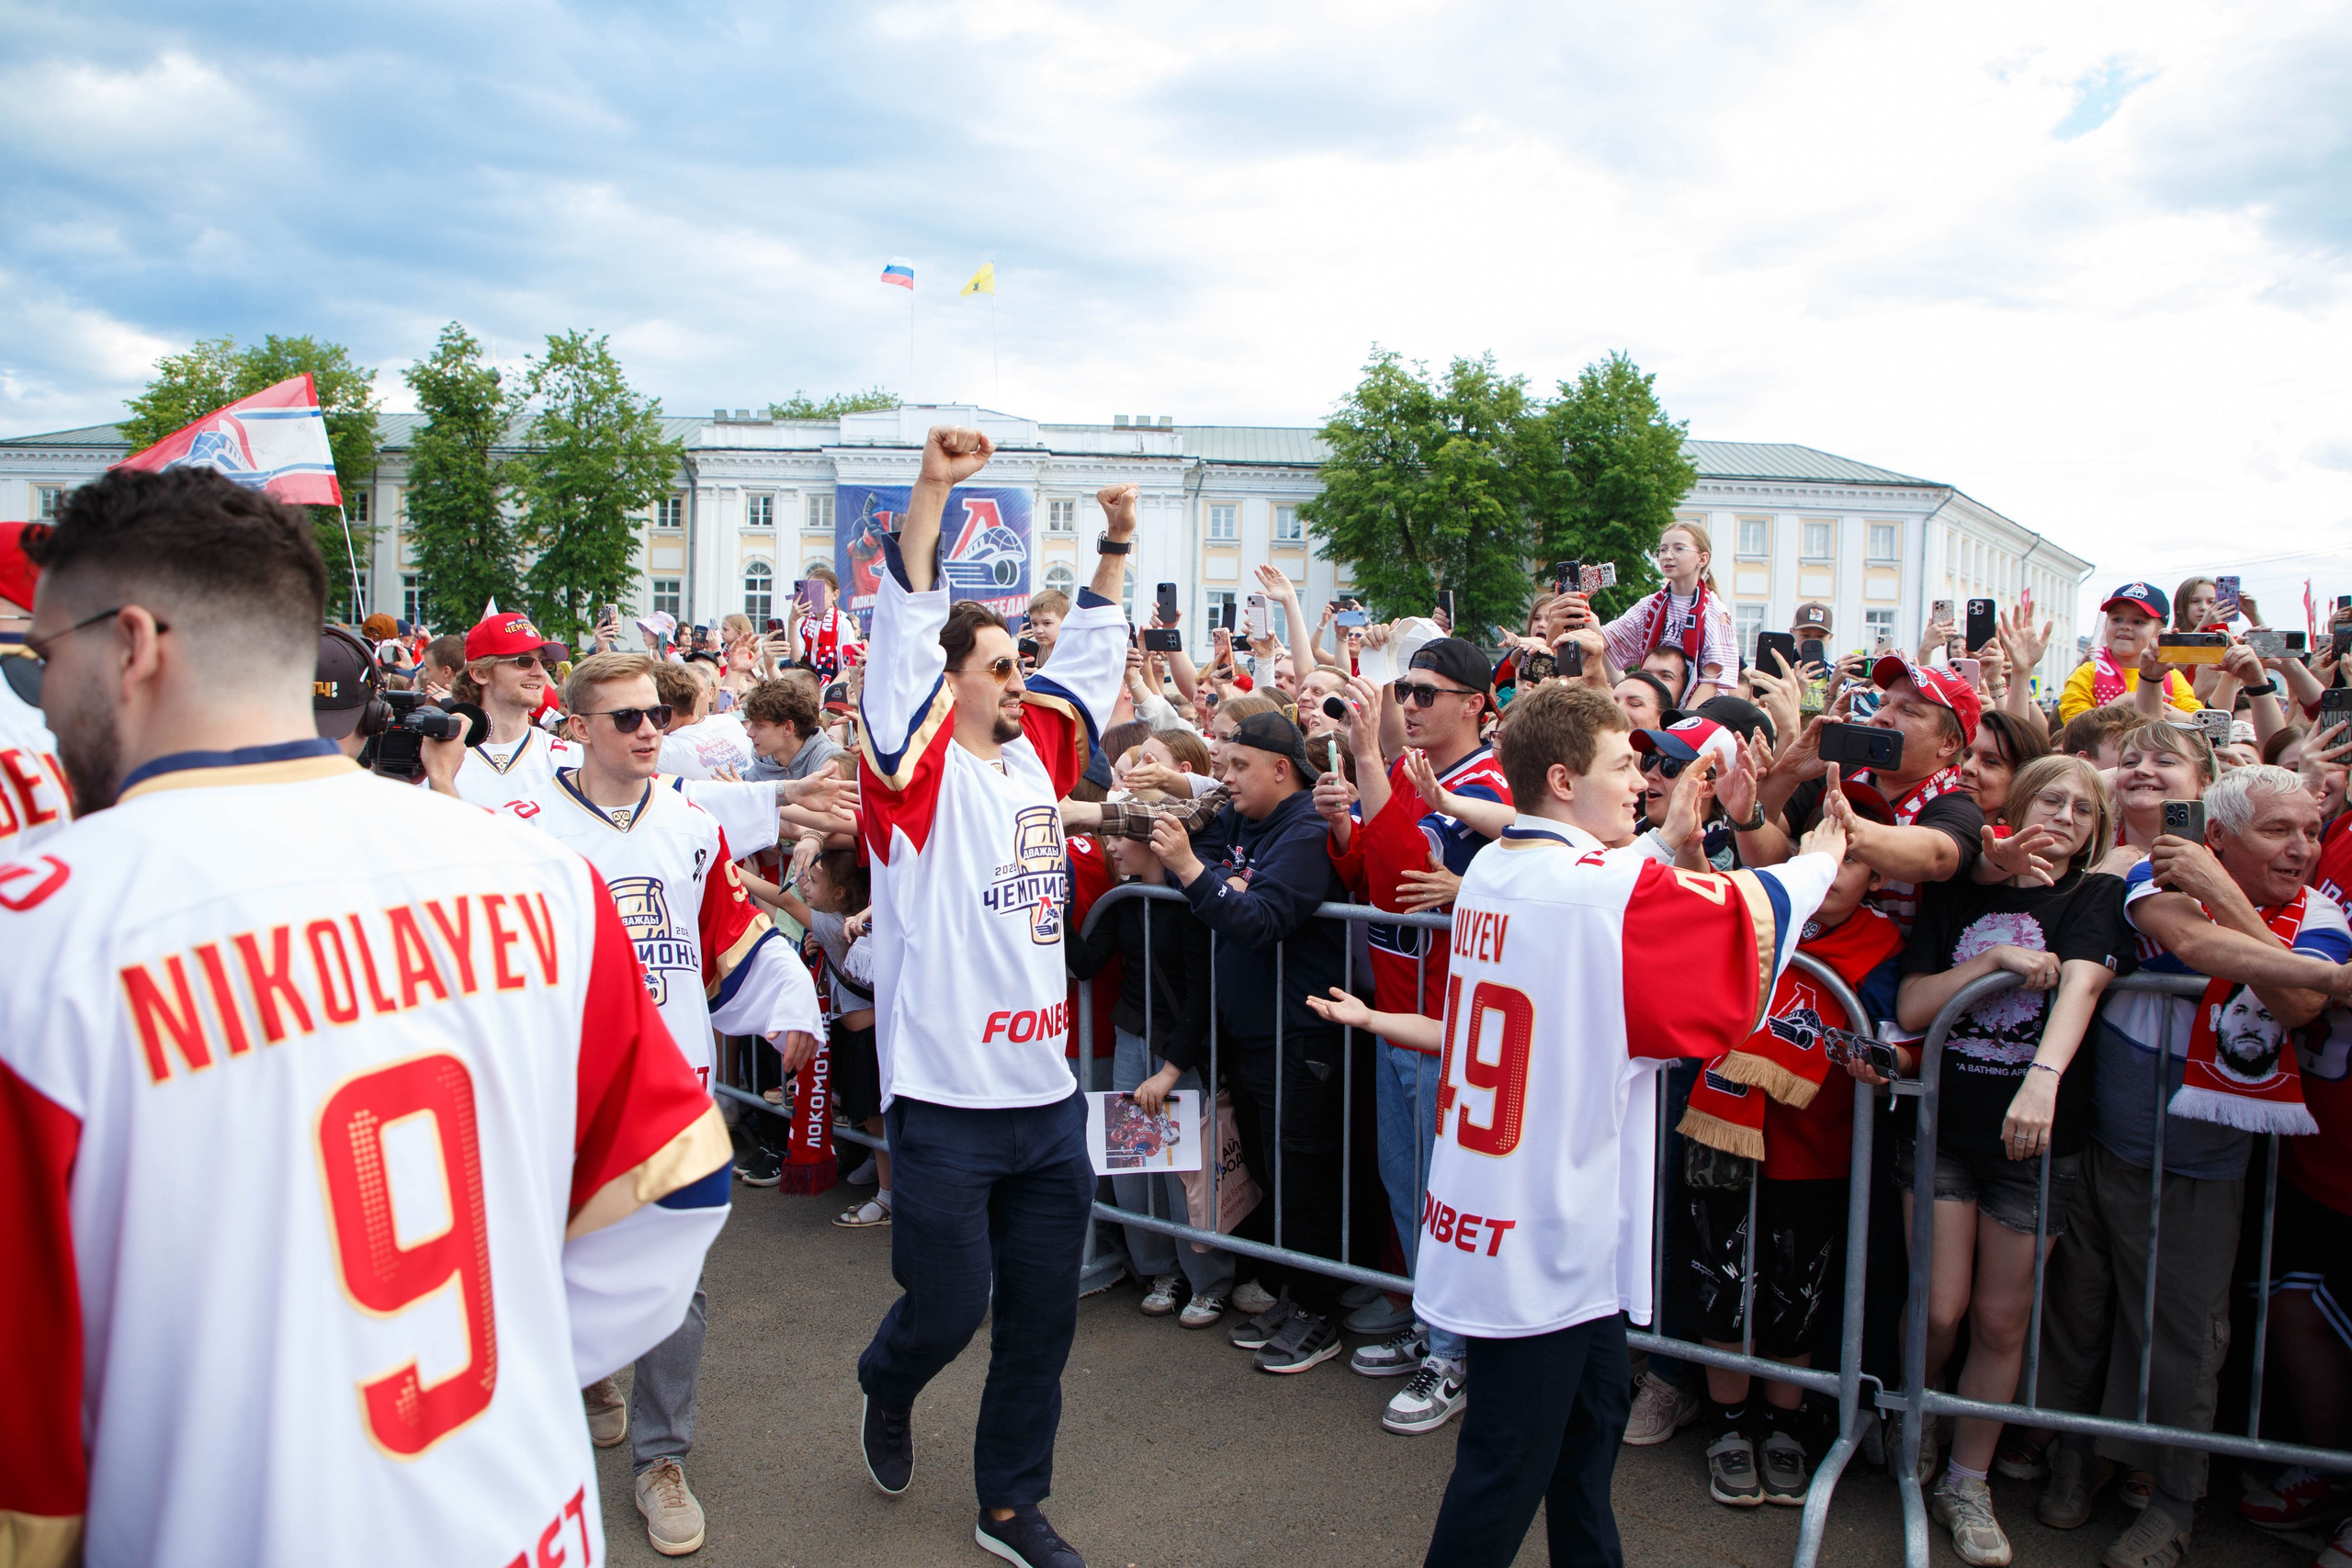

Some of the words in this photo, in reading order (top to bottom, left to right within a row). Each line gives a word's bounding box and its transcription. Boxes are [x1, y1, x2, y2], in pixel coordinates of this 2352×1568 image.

[119, 891, 560, 1086] NIKOLAYEV
[1968, 1064, 2009, 1077] BATHING
[311, 1048, 498, 1464] 9
